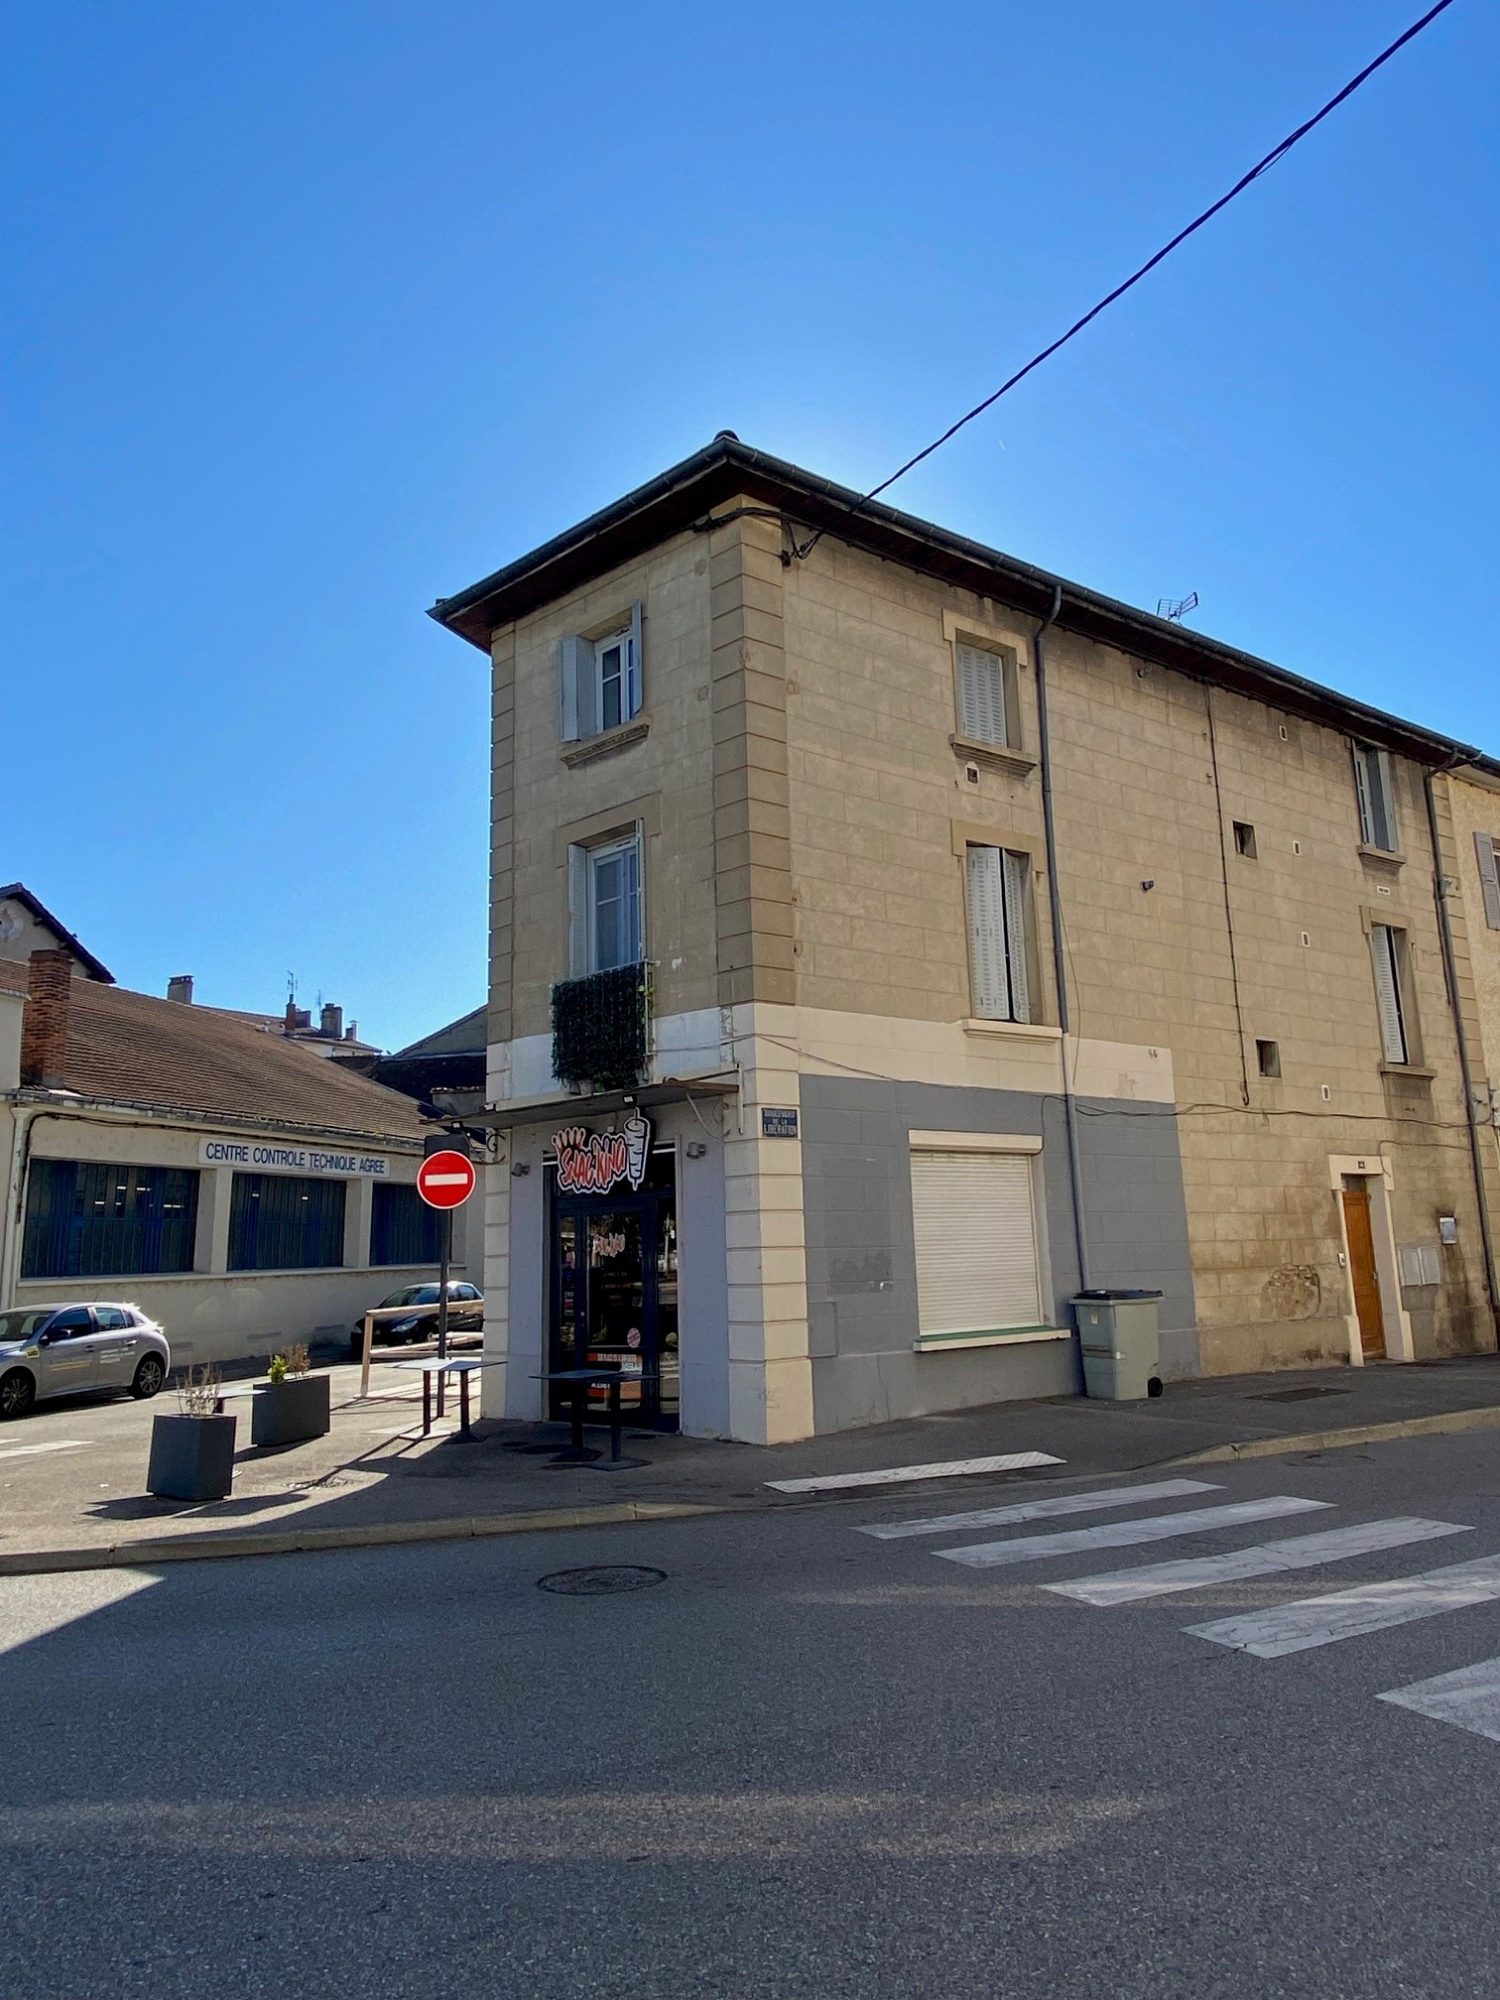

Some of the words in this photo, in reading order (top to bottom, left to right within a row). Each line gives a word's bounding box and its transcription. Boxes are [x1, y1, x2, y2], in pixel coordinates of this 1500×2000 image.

[206, 1143, 249, 1161] CENTRE
[253, 1147, 305, 1167] CONTROLE
[309, 1153, 356, 1171] TECHNIQUE
[359, 1157, 385, 1174] AGREE
